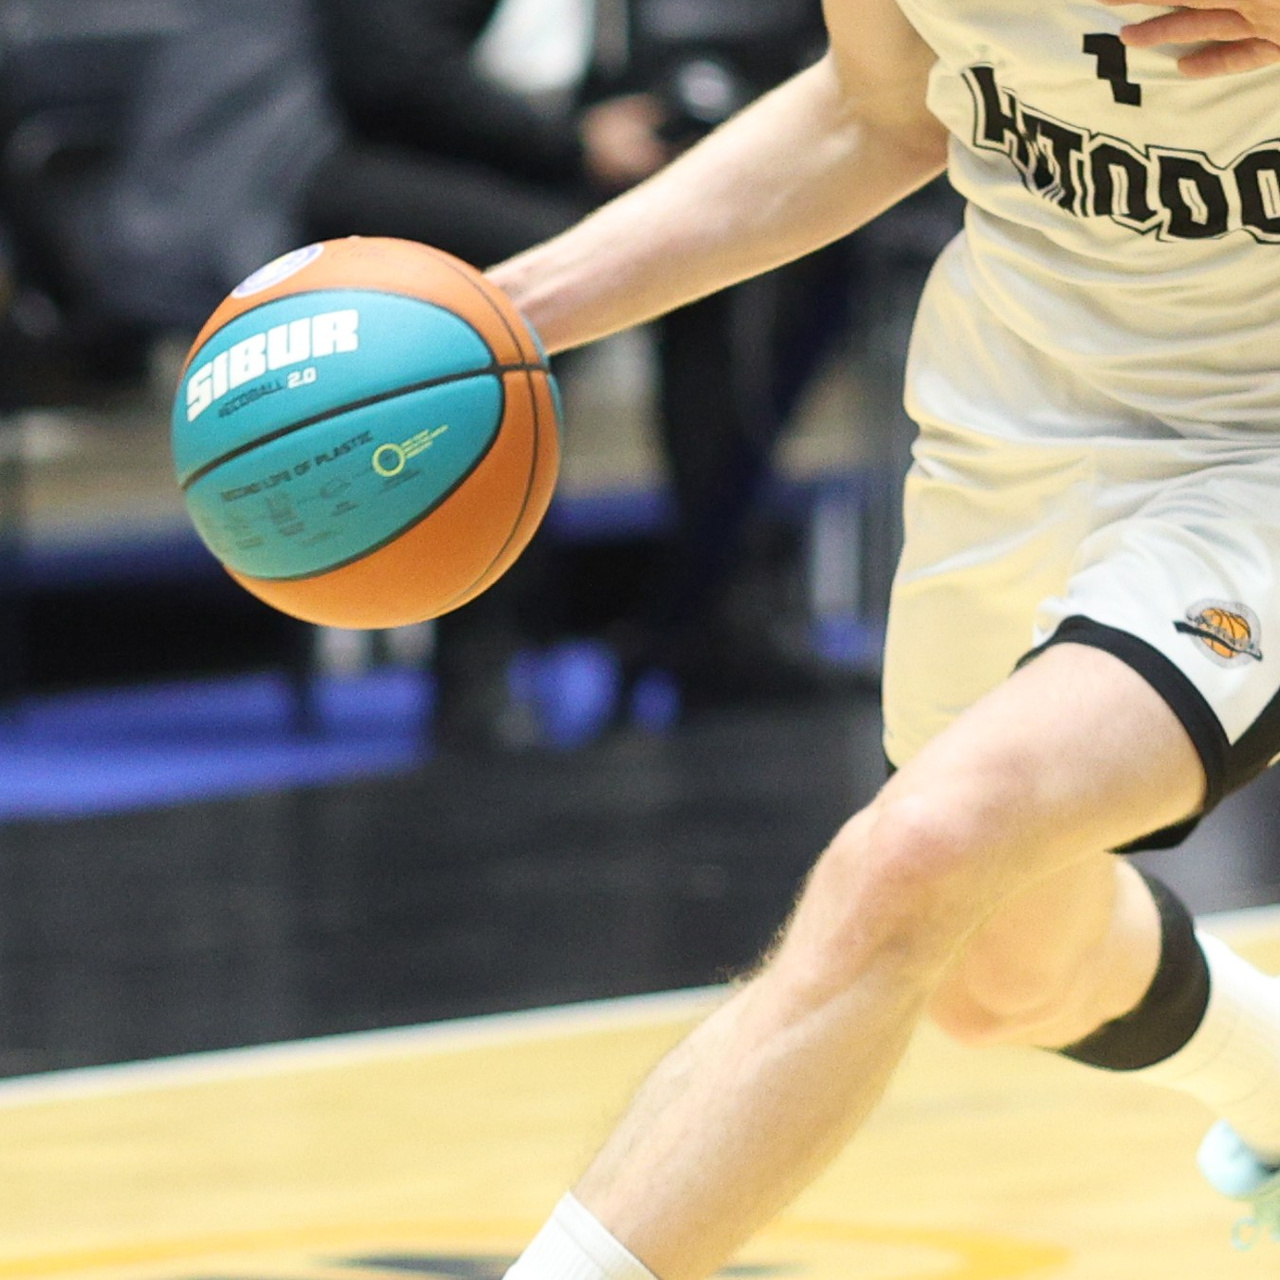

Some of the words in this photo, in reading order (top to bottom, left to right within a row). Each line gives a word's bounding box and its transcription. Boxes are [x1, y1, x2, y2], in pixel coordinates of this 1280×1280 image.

[186, 309, 359, 422] SIBUR
[287, 367, 317, 389] 2.0
[294, 460, 312, 476] OF
[315, 430, 374, 466] PLASTIC
